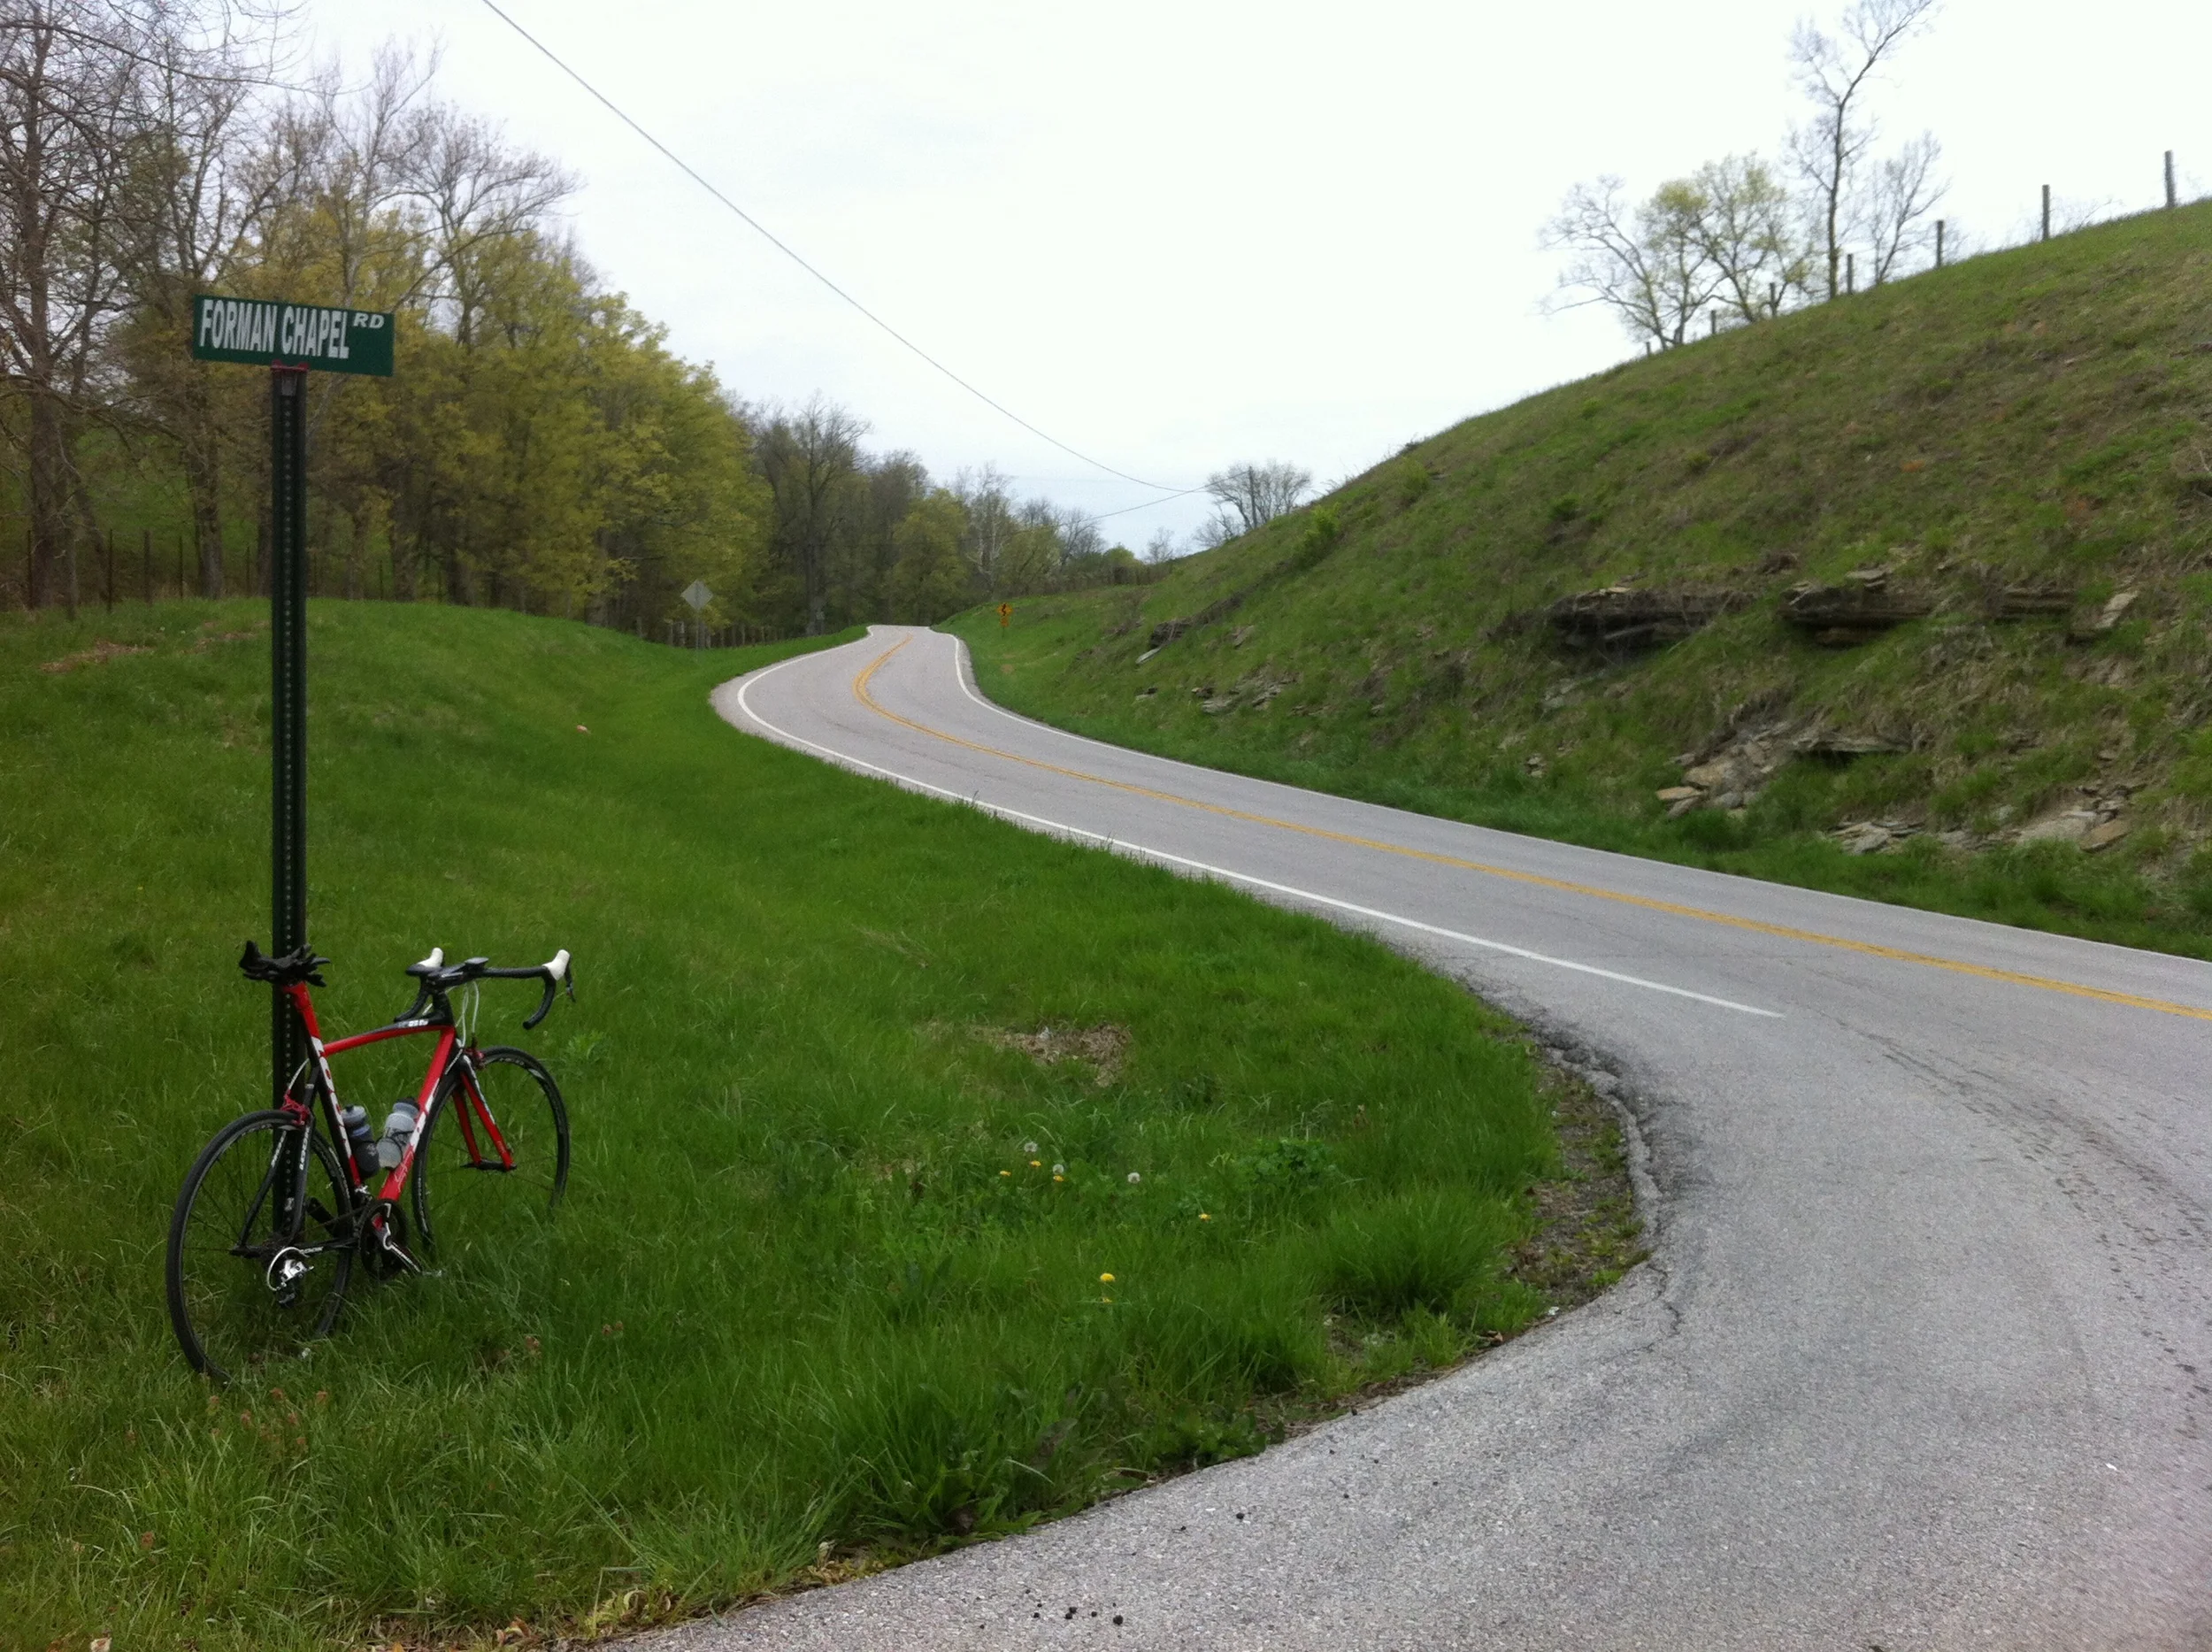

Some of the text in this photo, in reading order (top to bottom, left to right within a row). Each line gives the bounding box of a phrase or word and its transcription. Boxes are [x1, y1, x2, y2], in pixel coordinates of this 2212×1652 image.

[199, 299, 385, 359] FORMAN CHAPEL RD
